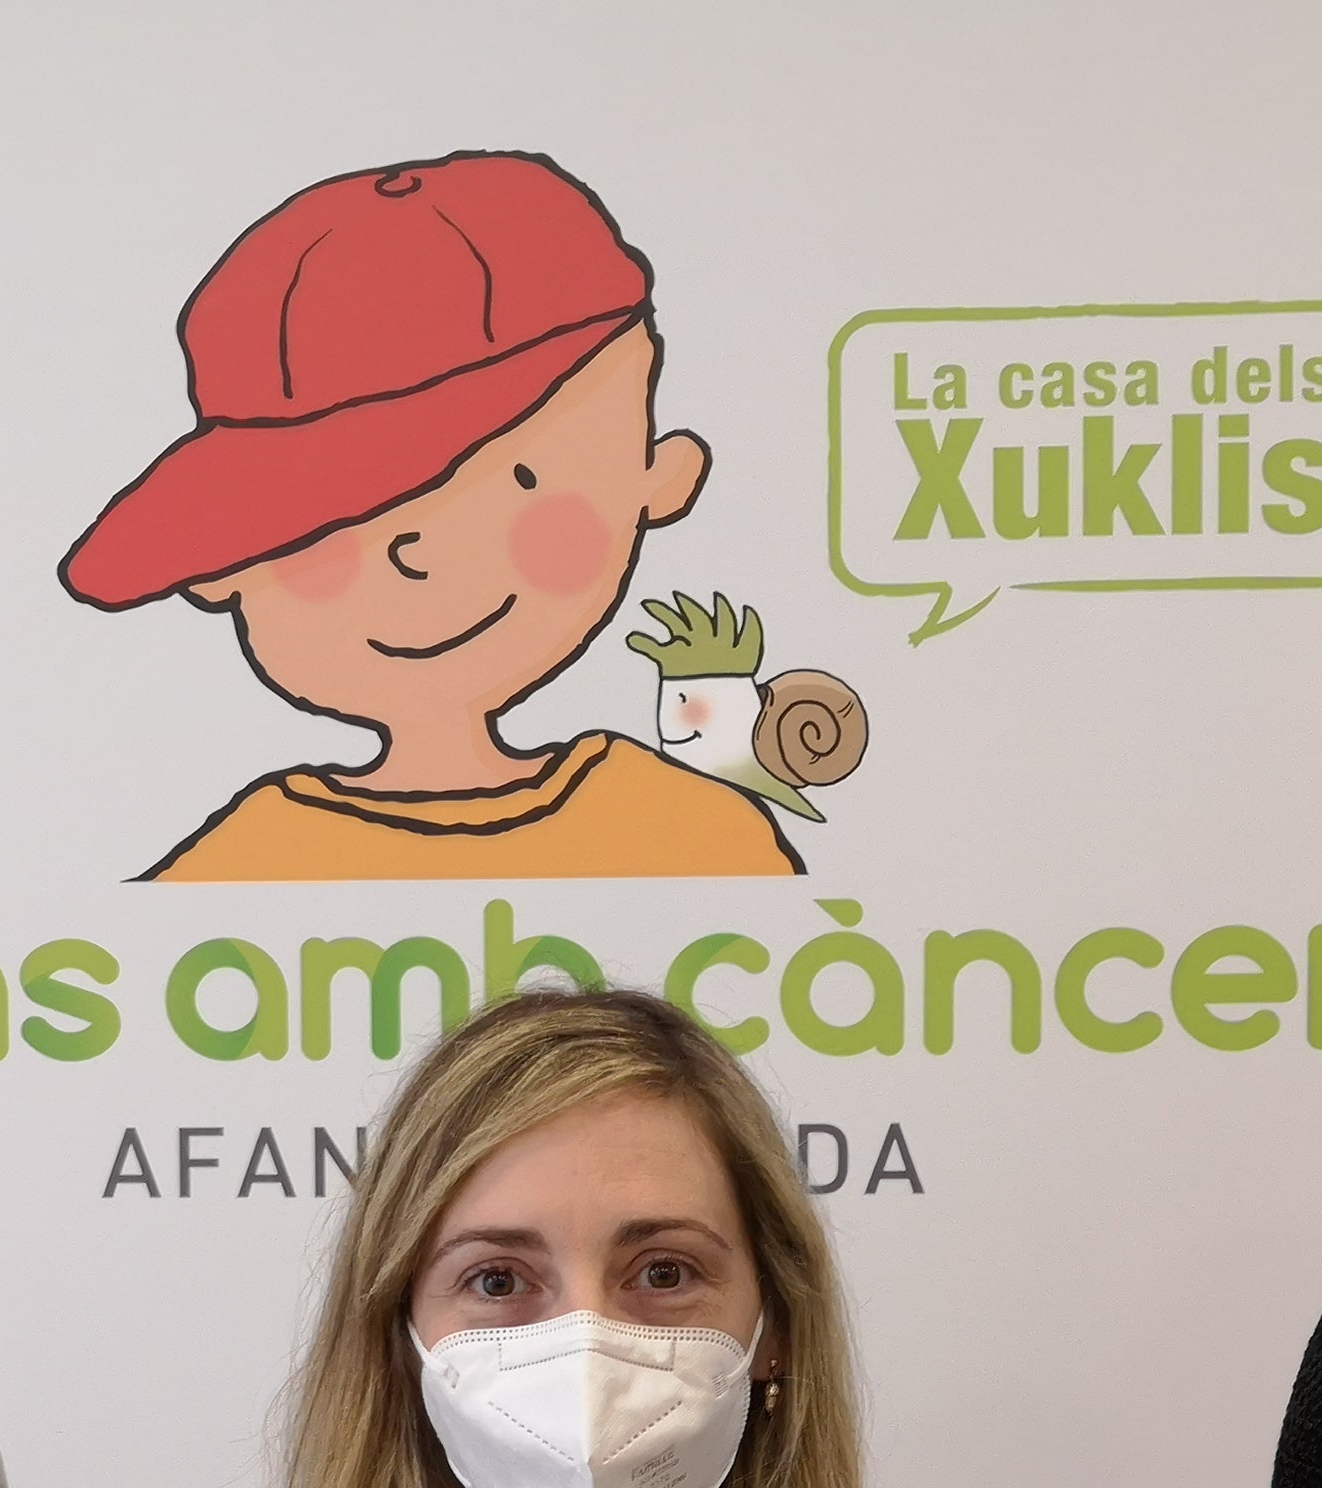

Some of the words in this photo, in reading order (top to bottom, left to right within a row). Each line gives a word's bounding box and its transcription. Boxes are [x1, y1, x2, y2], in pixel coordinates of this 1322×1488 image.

[893, 352, 968, 411] La
[998, 360, 1160, 409] casa
[165, 898, 608, 1062] amb
[101, 1126, 369, 1199] AFAN
[797, 1122, 925, 1196] DA
